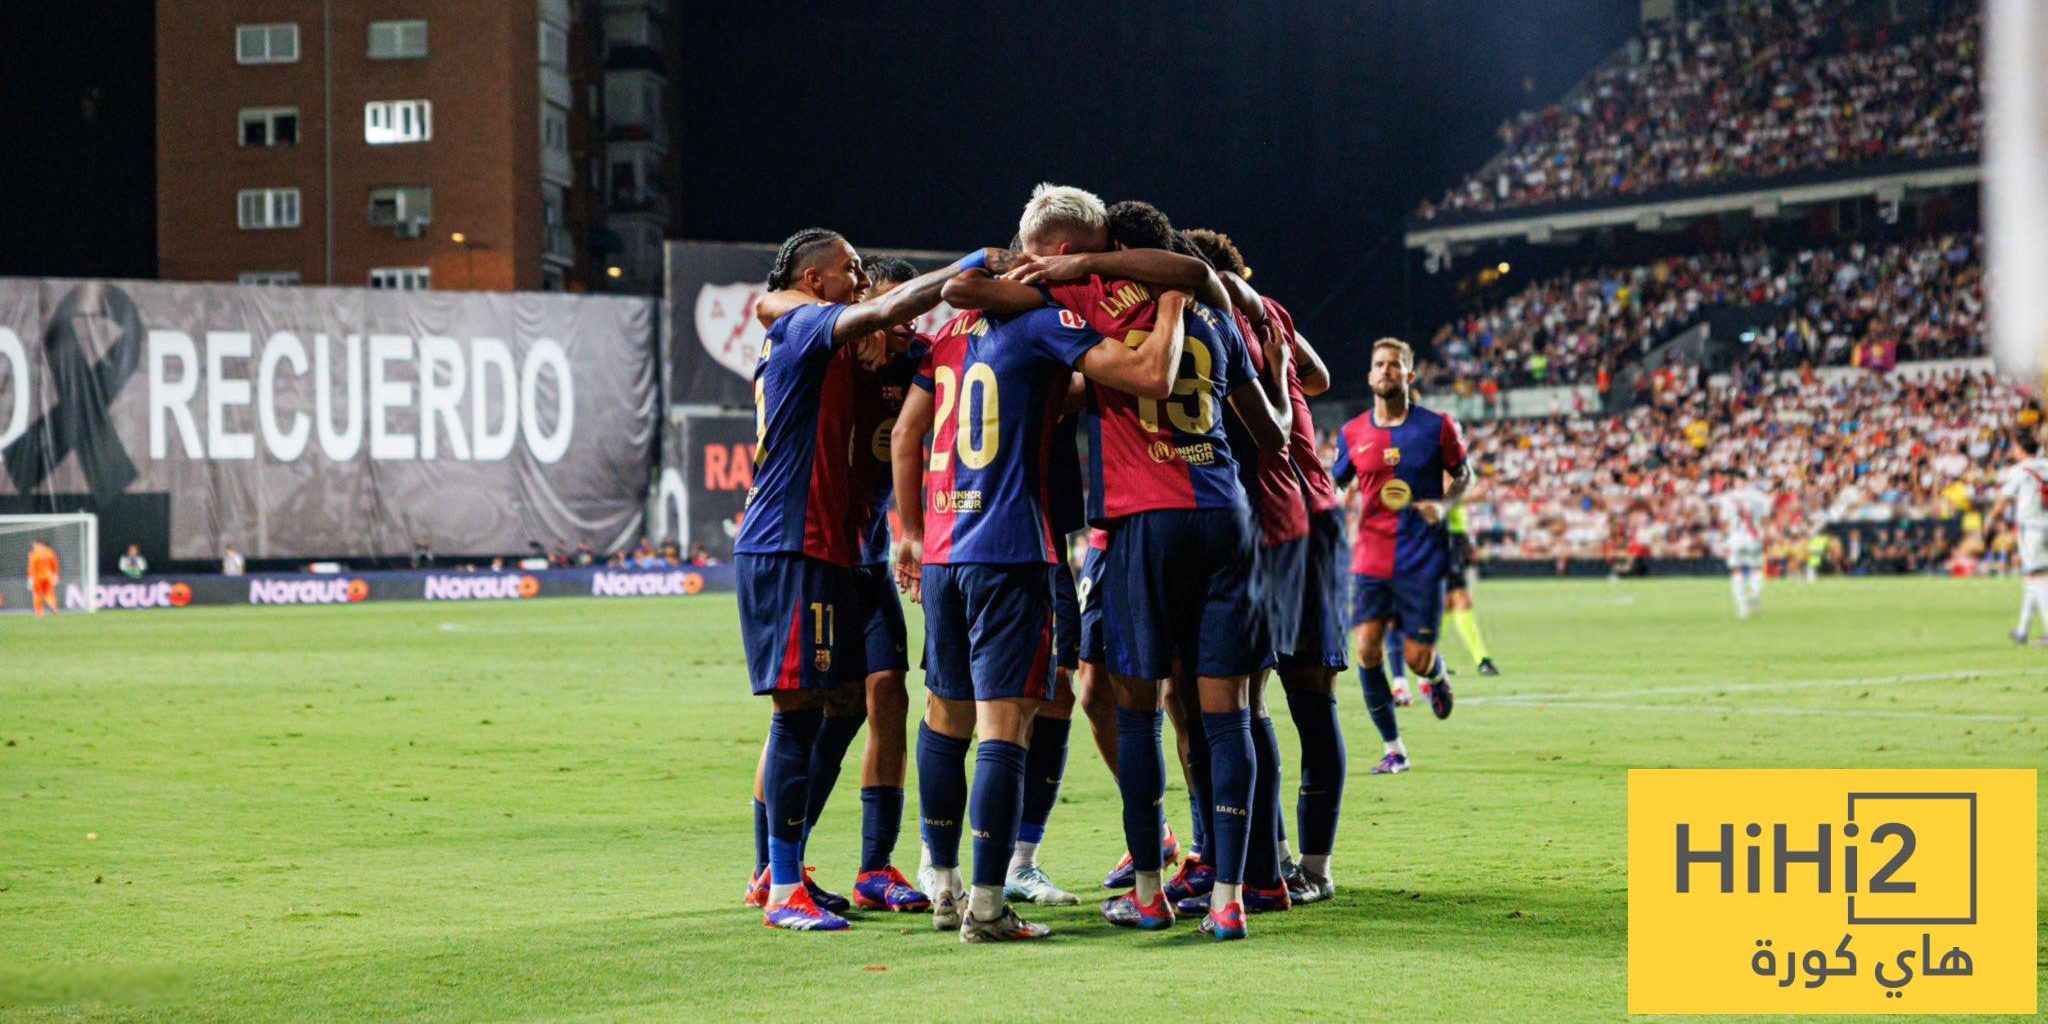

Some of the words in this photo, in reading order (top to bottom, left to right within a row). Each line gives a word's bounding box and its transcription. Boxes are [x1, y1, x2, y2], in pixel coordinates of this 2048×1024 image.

[148, 330, 574, 463] RECUERDO
[930, 362, 999, 472] 20
[810, 602, 834, 647] 11
